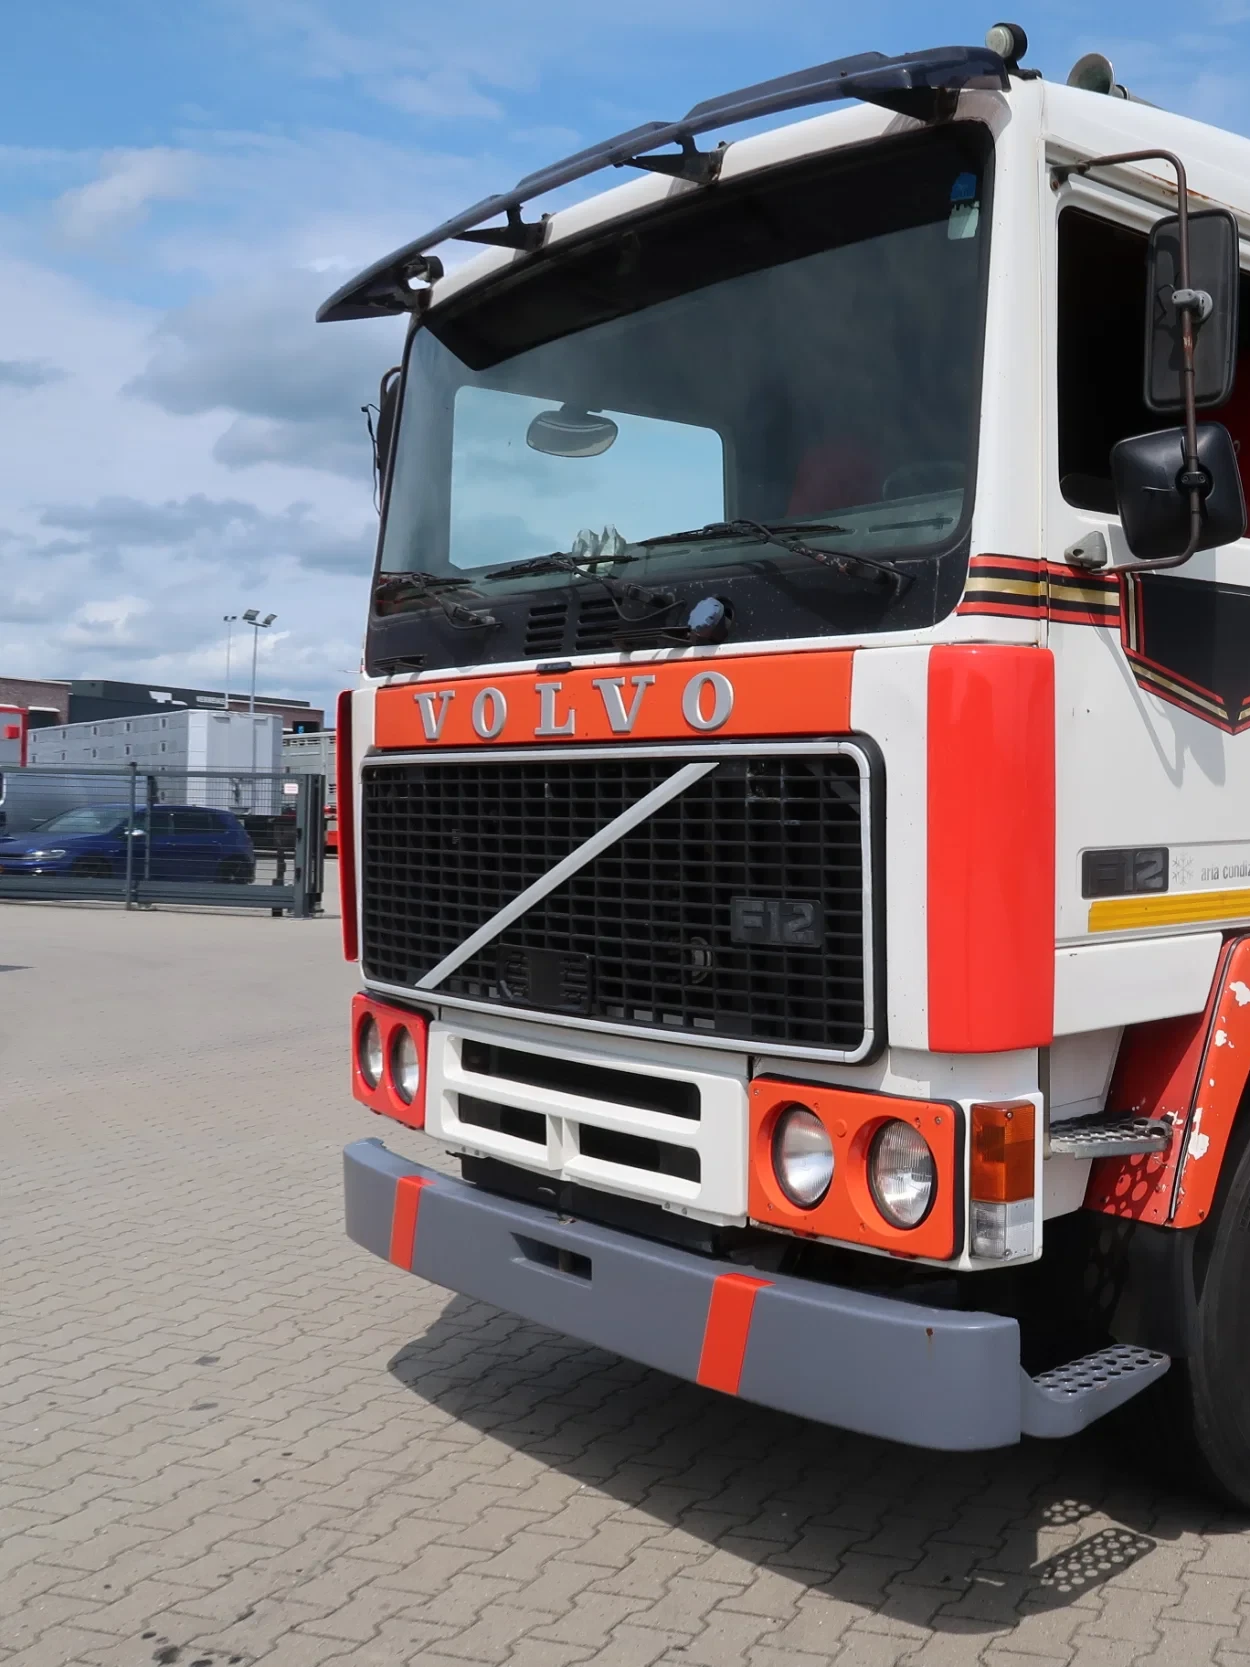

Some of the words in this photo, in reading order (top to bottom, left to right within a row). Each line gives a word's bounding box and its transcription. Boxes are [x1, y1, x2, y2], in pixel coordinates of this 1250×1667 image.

[413, 670, 735, 741] VOLVO
[1201, 864, 1219, 881] aria
[734, 899, 815, 946] F12
